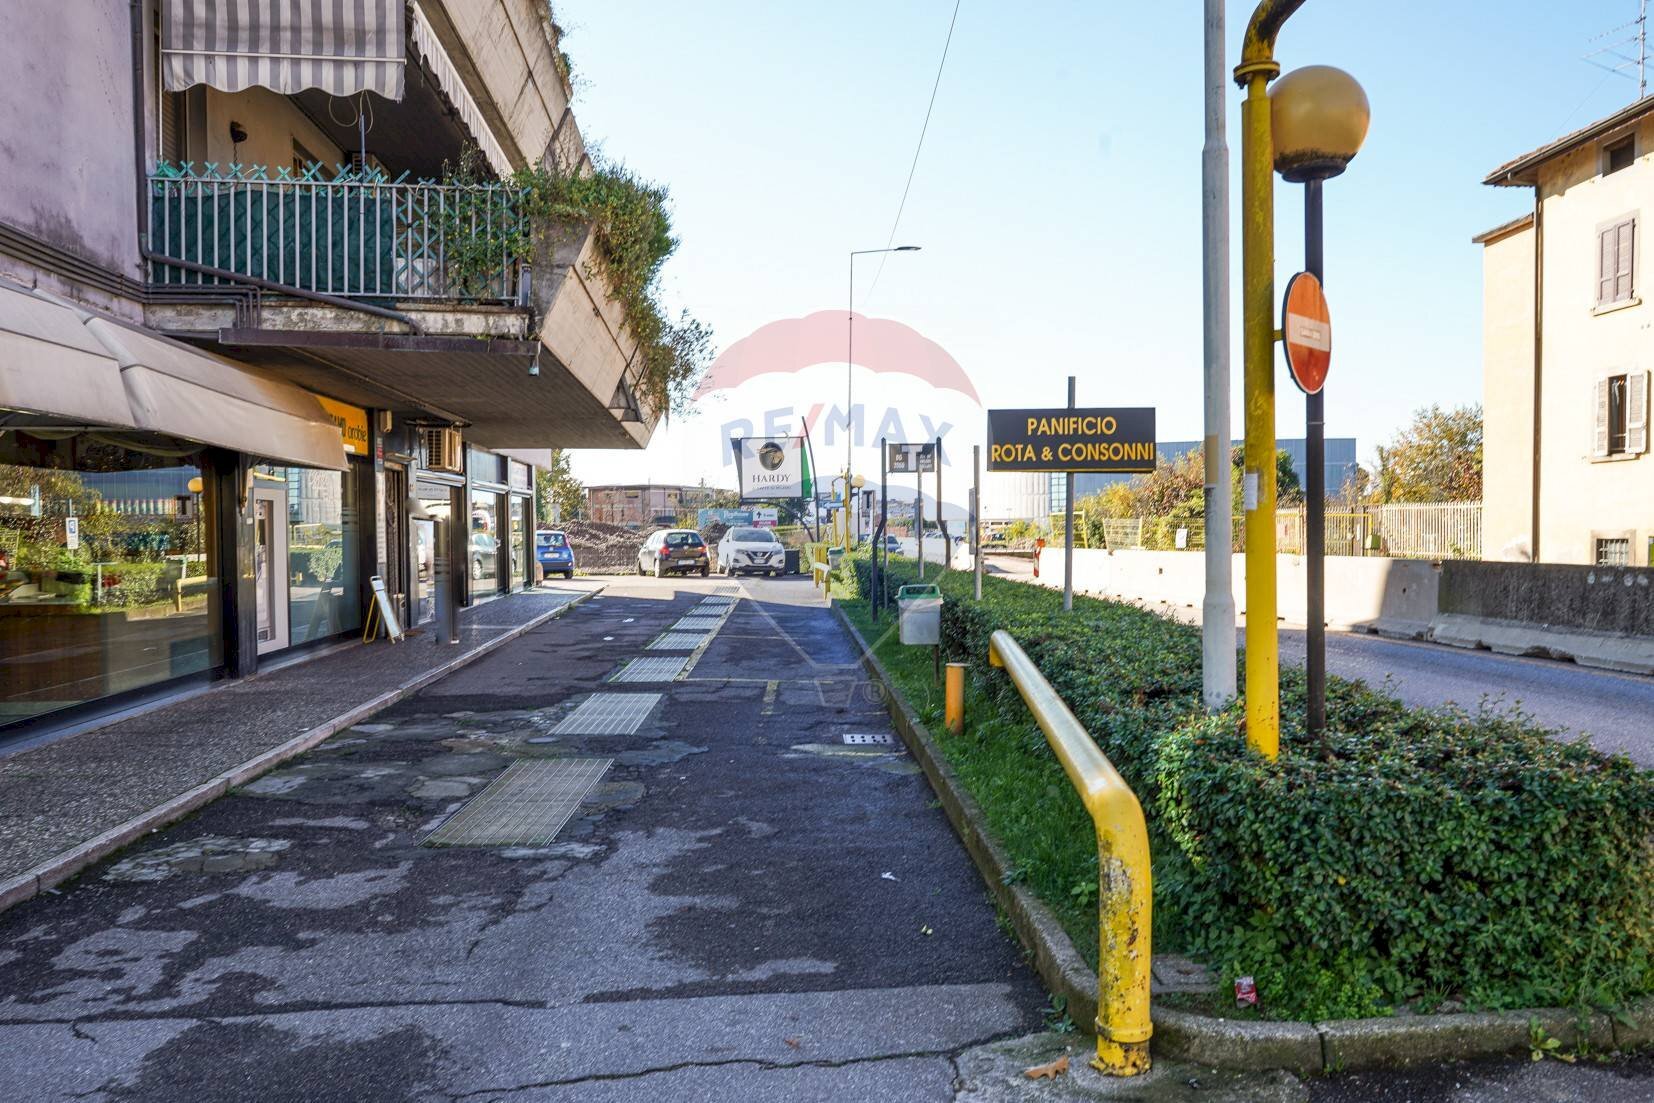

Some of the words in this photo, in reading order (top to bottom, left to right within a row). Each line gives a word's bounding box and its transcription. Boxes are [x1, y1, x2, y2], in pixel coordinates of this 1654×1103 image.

[1027, 416, 1117, 436] PANIFICIO
[991, 444, 1037, 462] ROTA
[1041, 446, 1053, 461] &
[1058, 442, 1154, 462] CONSONNI
[752, 472, 791, 483] HARDY
